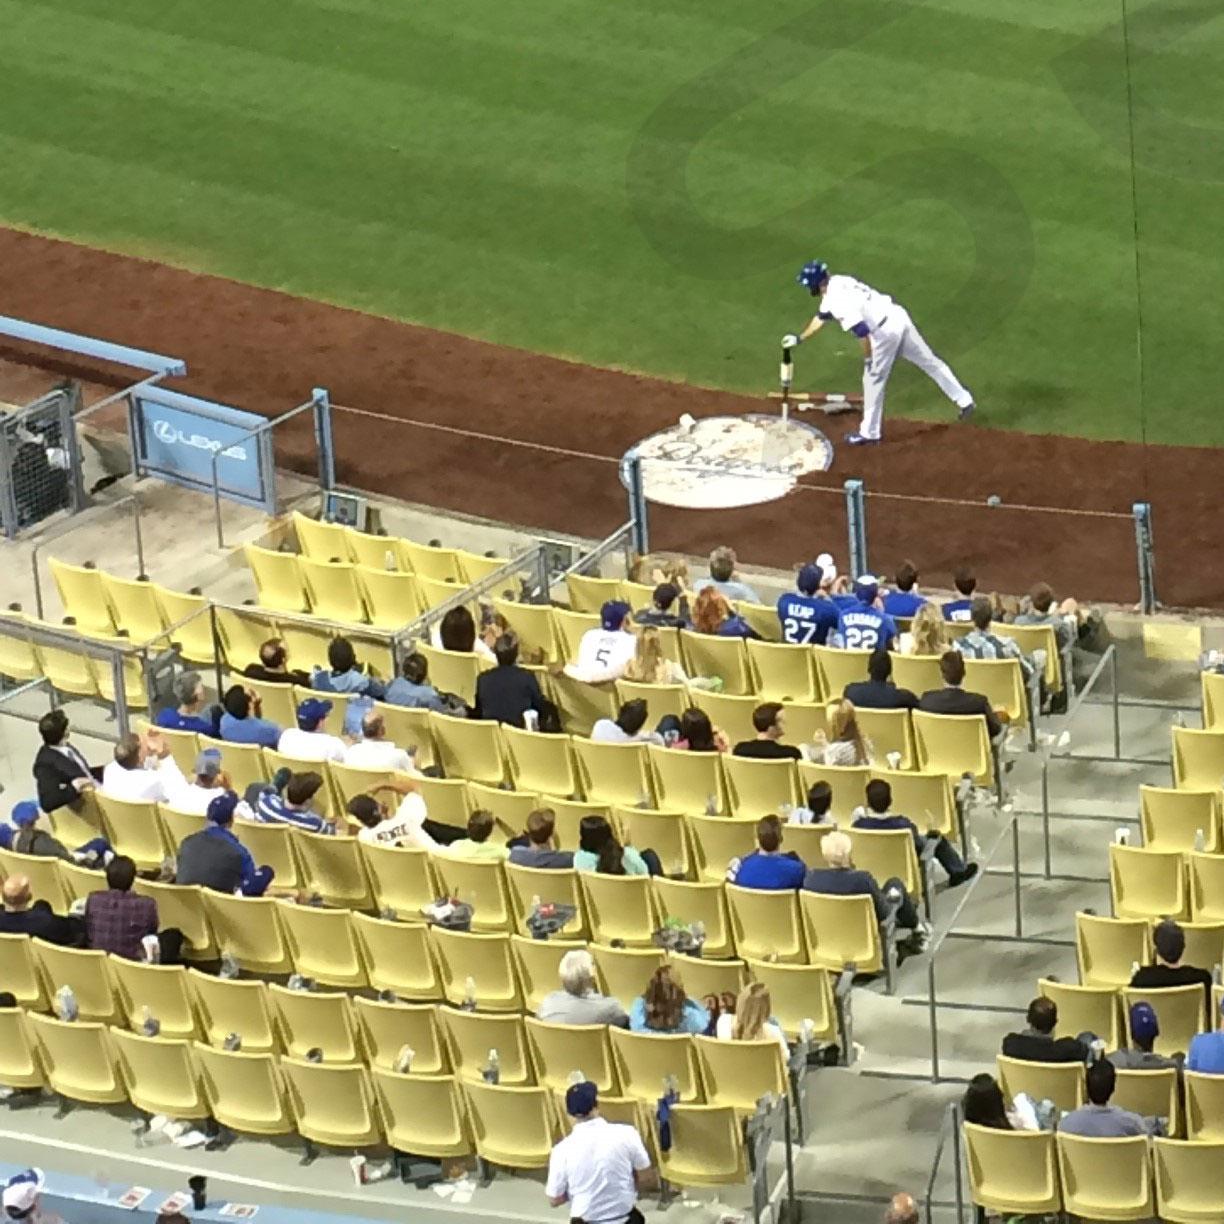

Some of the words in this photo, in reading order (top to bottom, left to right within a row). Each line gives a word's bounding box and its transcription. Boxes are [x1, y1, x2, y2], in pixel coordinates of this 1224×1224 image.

[784, 618, 816, 645] 27
[845, 627, 878, 652] 22
[596, 648, 611, 668] 5
